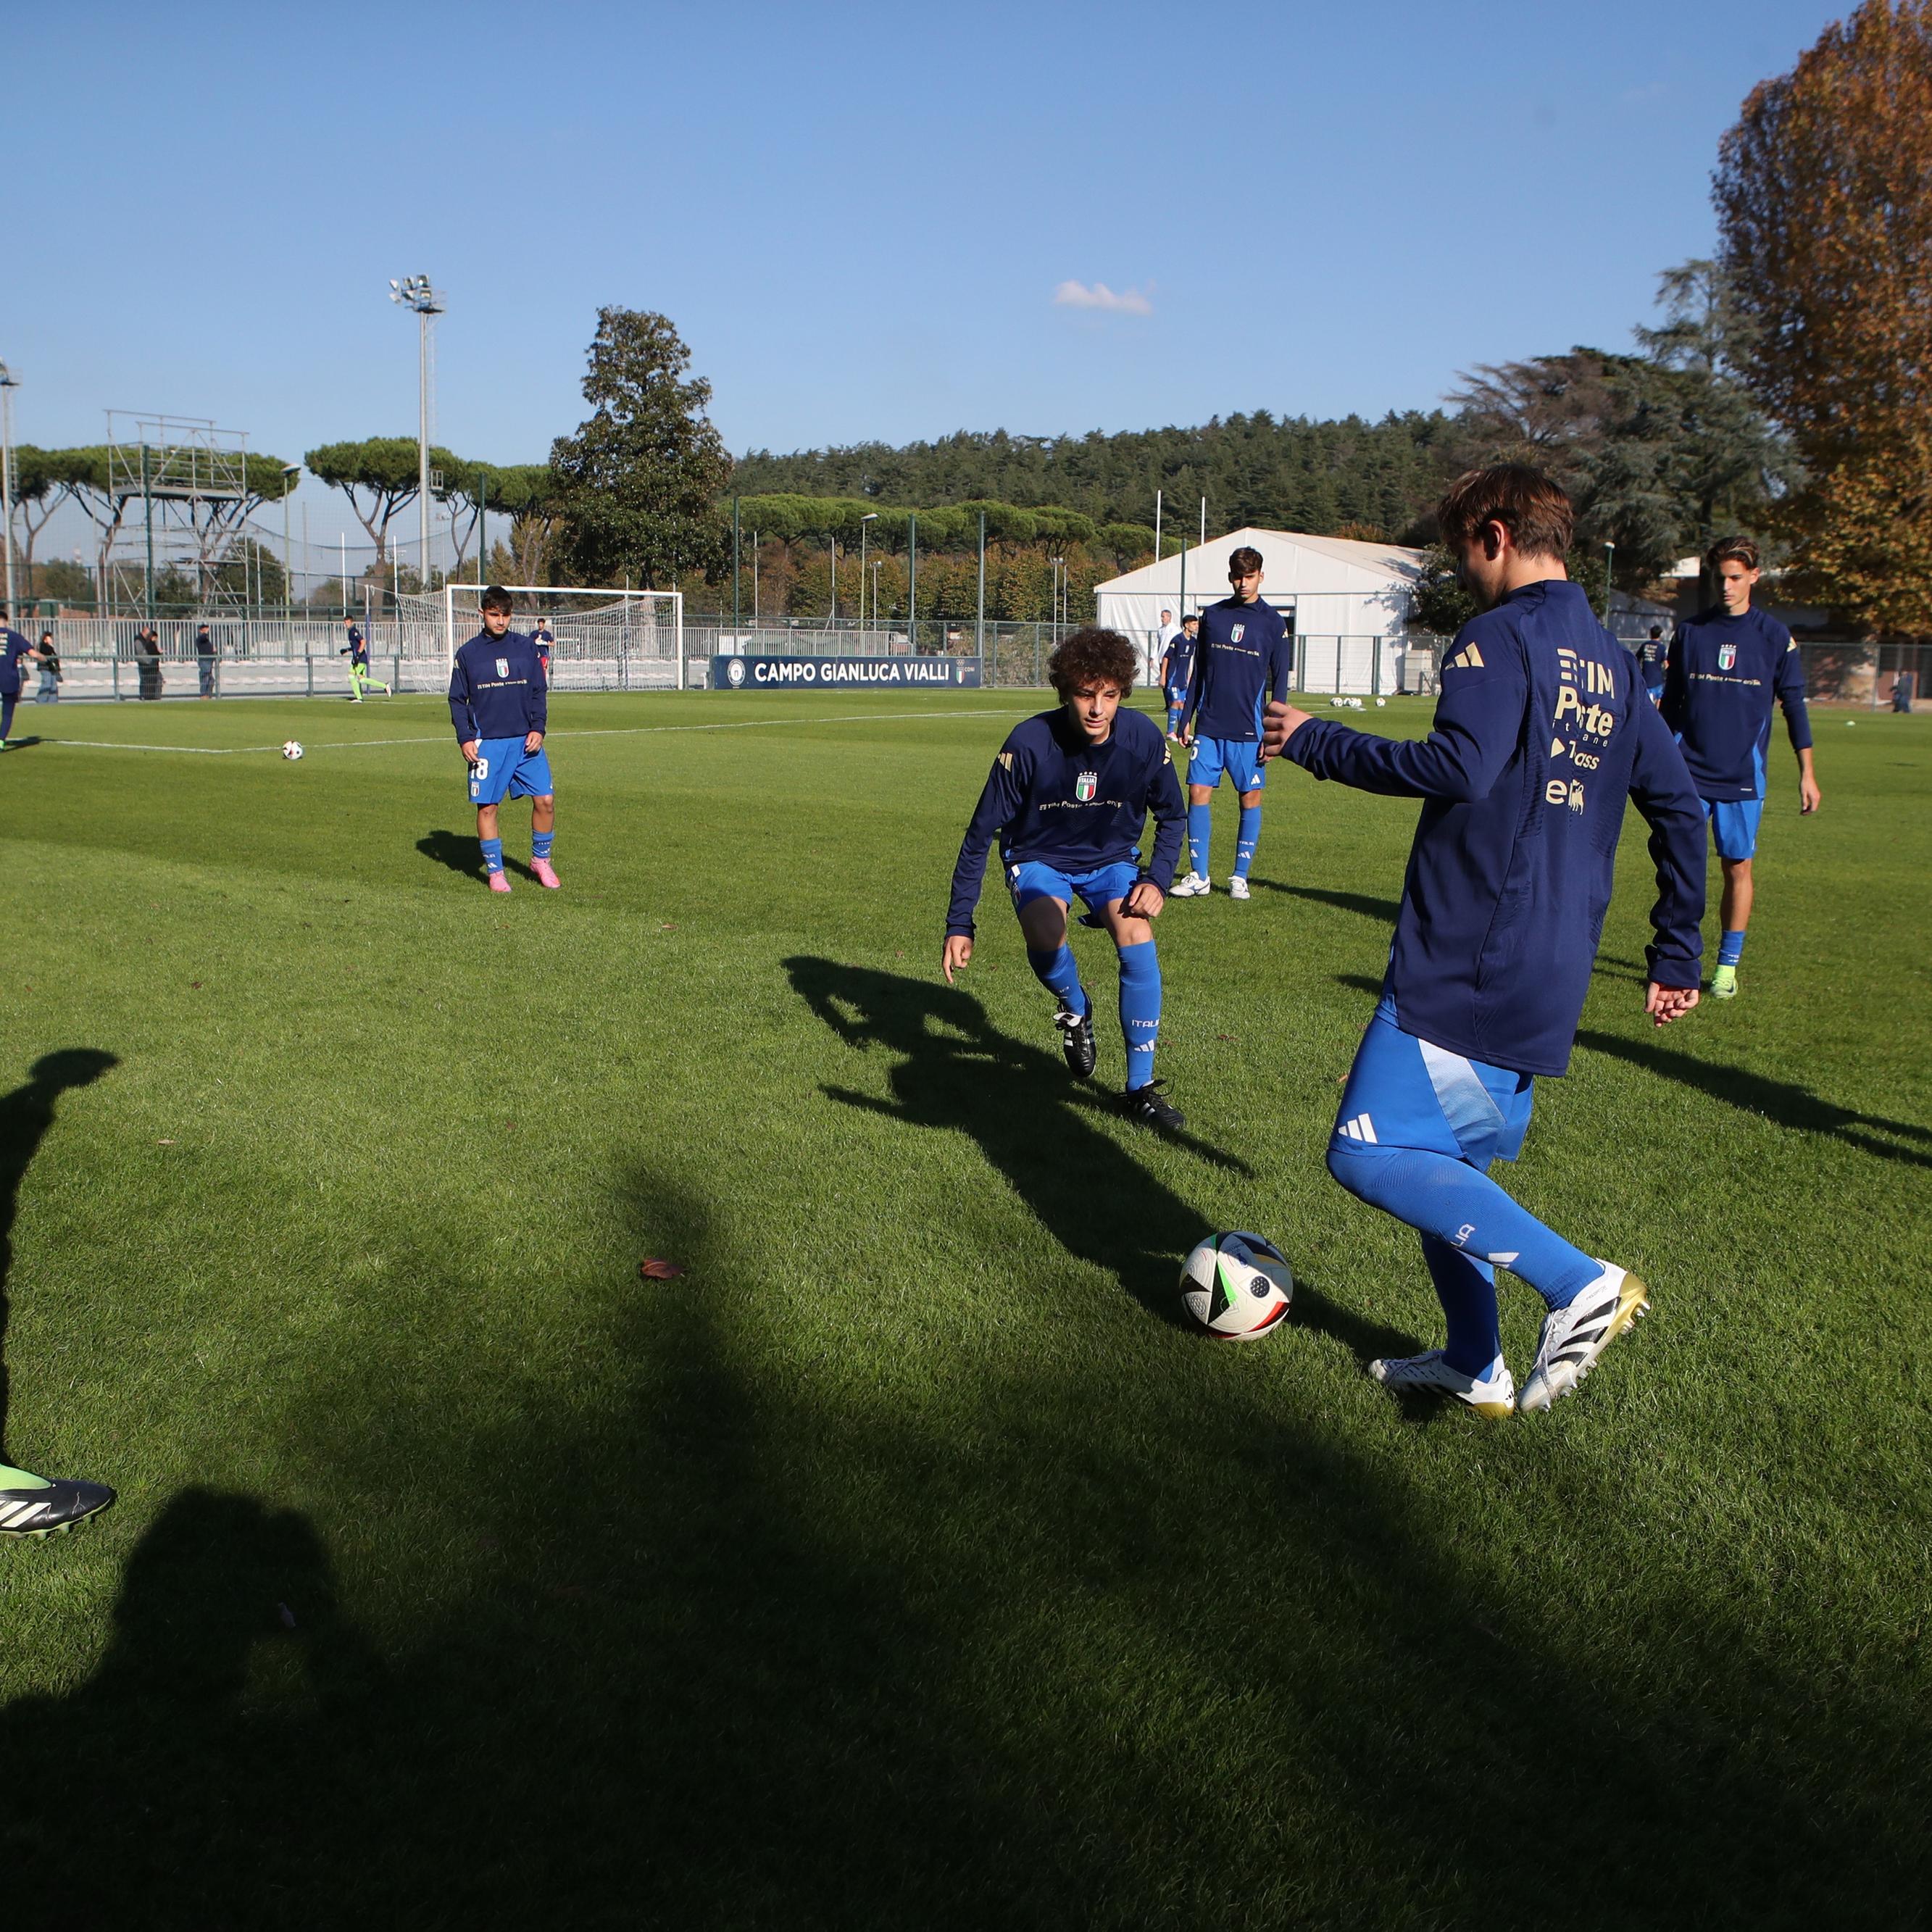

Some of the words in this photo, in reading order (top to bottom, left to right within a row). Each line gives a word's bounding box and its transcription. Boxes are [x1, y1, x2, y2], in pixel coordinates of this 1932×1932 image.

[754, 662, 816, 682] CAMPO
[820, 663, 901, 682] GIANLUCA
[904, 663, 949, 680] VIALLI
[1132, 1019, 1159, 1028] ITALI
